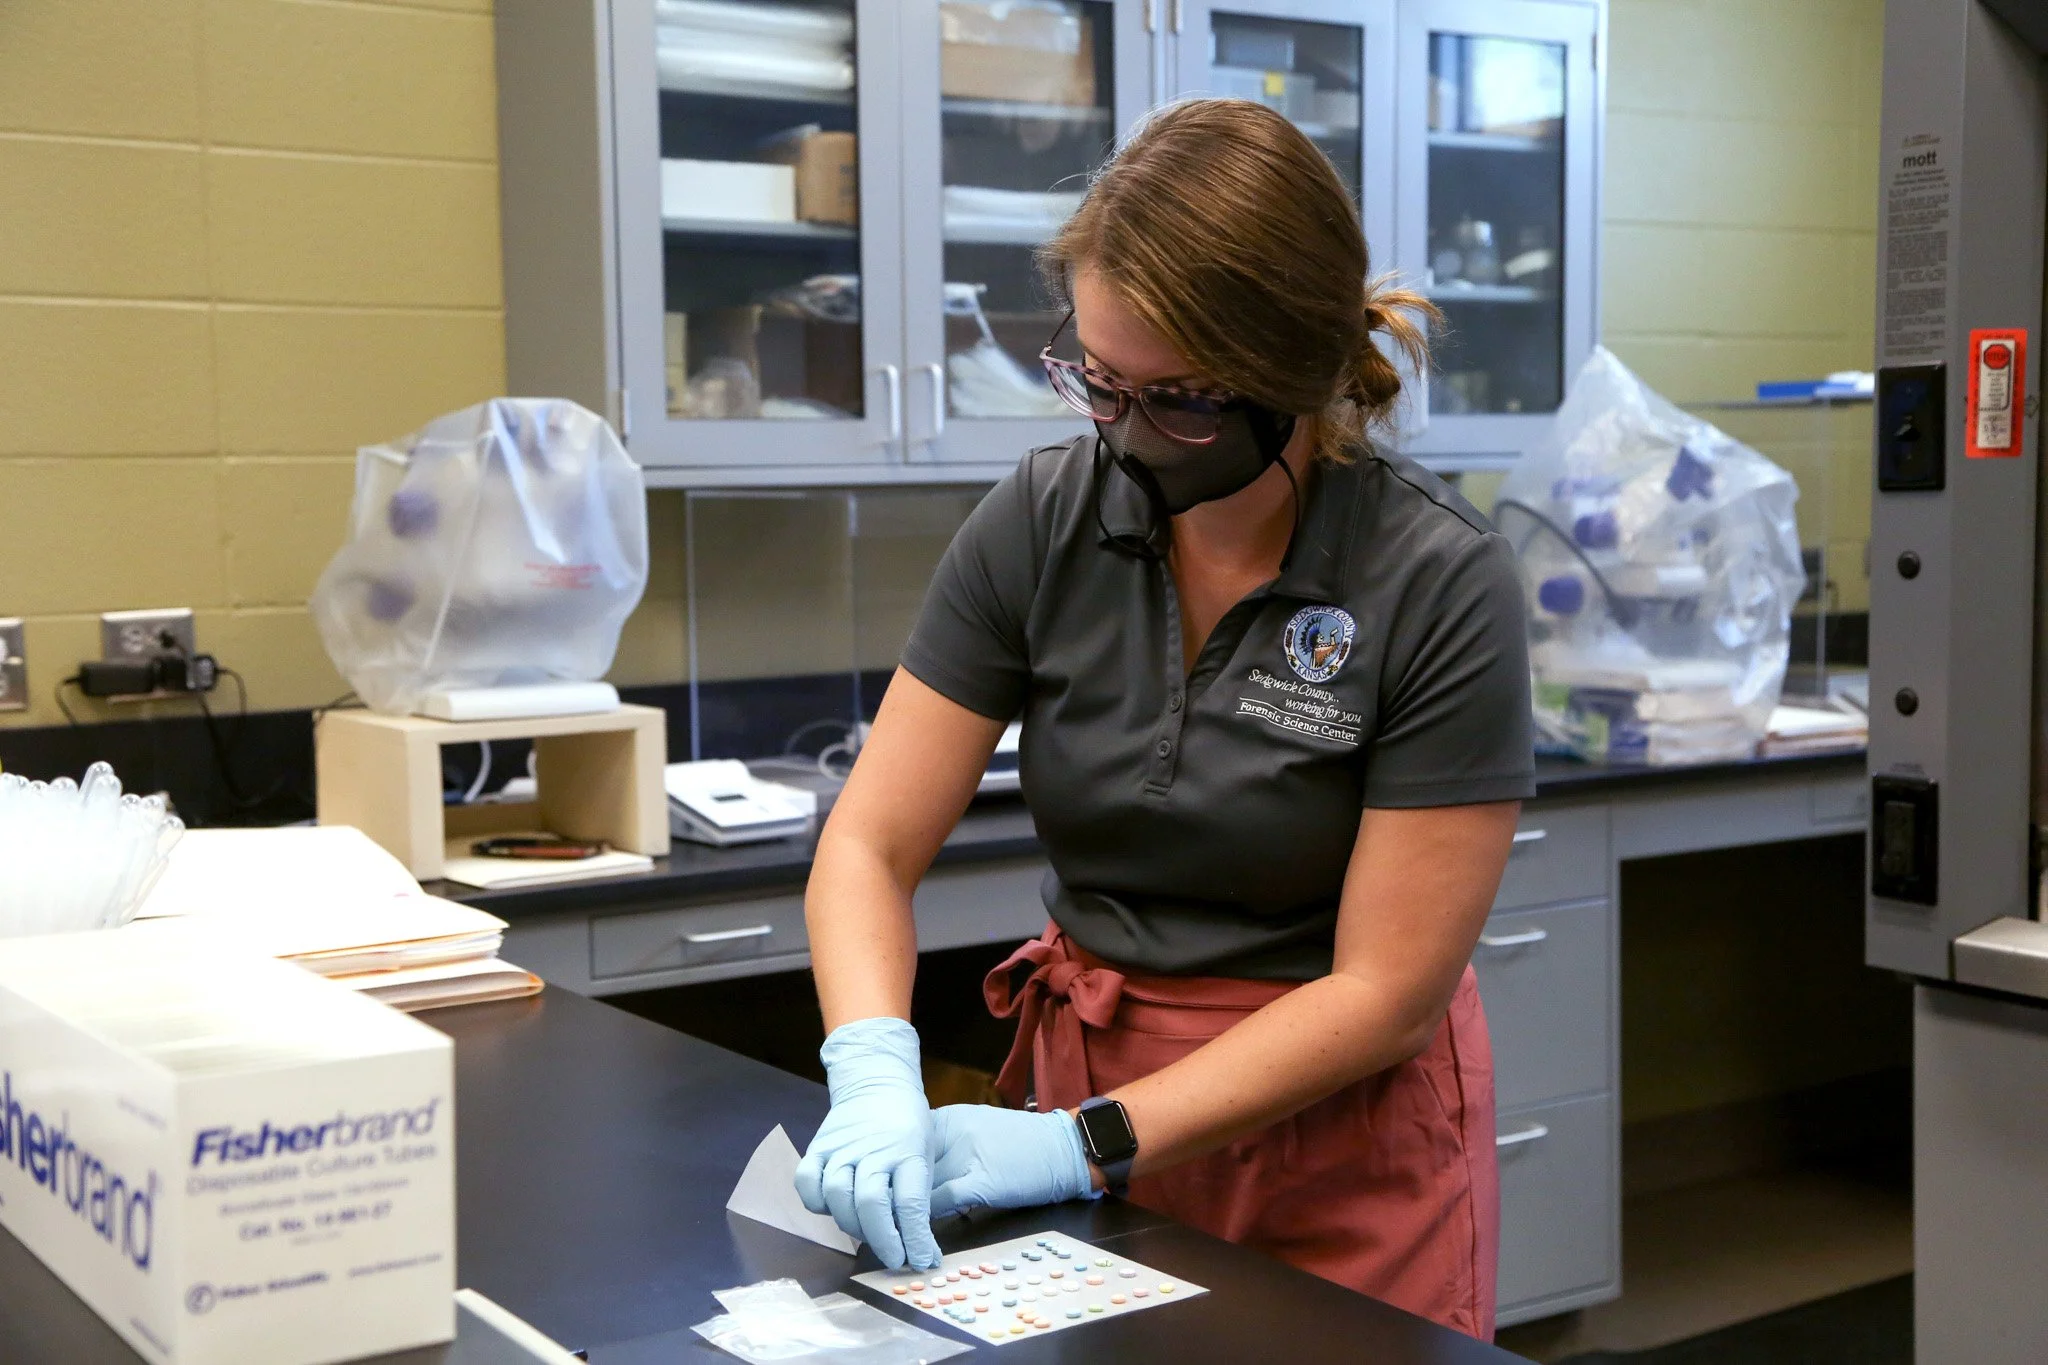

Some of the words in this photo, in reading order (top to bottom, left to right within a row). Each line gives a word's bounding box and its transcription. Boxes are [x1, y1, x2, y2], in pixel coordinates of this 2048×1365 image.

[1903, 150, 1937, 168] mott
[1290, 605, 1333, 628] SEDGWICK
[1248, 669, 1298, 693] Sedgwick
[1296, 665, 1328, 680] KANSAS
[1240, 702, 1281, 722] Forensic
[1283, 716, 1319, 734] Science
[1321, 725, 1357, 742] Center
[1285, 698, 1323, 718] working
[1323, 704, 1340, 719] for
[1338, 711, 1362, 724] you
[191, 1097, 439, 1167] Fisherbrand
